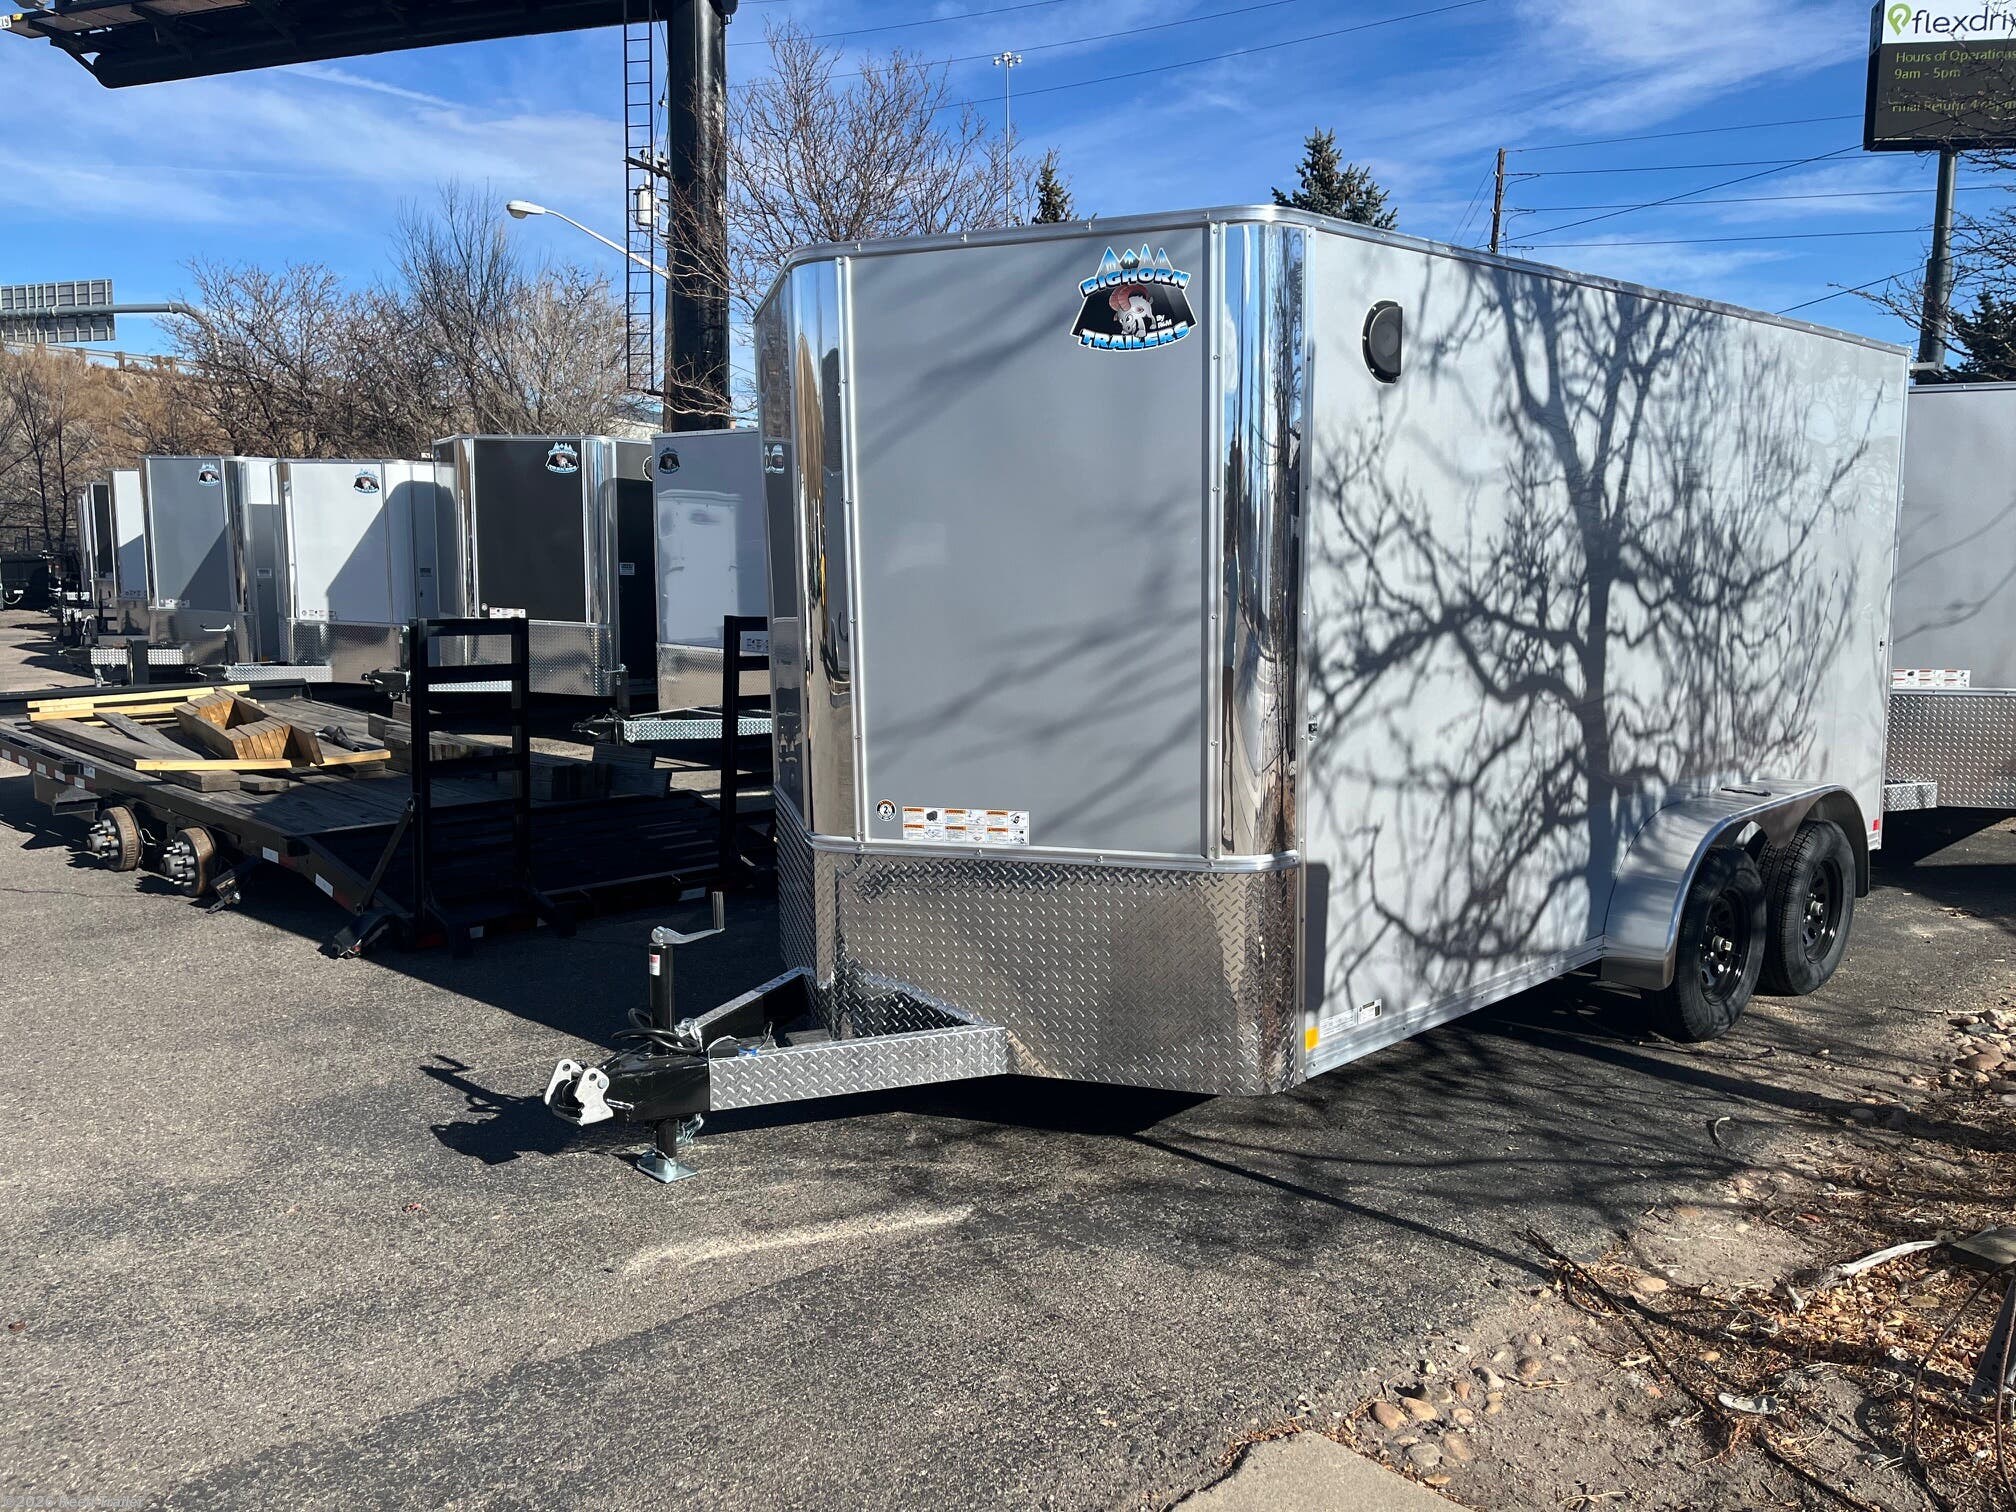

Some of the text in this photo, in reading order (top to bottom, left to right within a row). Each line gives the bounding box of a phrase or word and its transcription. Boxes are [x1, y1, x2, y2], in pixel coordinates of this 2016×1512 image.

[1895, 51, 1931, 63] Hours
[1934, 50, 1947, 62] of
[1894, 69, 1921, 80] 9am
[1933, 67, 1961, 80] 5pm
[1081, 267, 1191, 298] BIGHORN
[1080, 321, 1190, 350] TRAILERS
